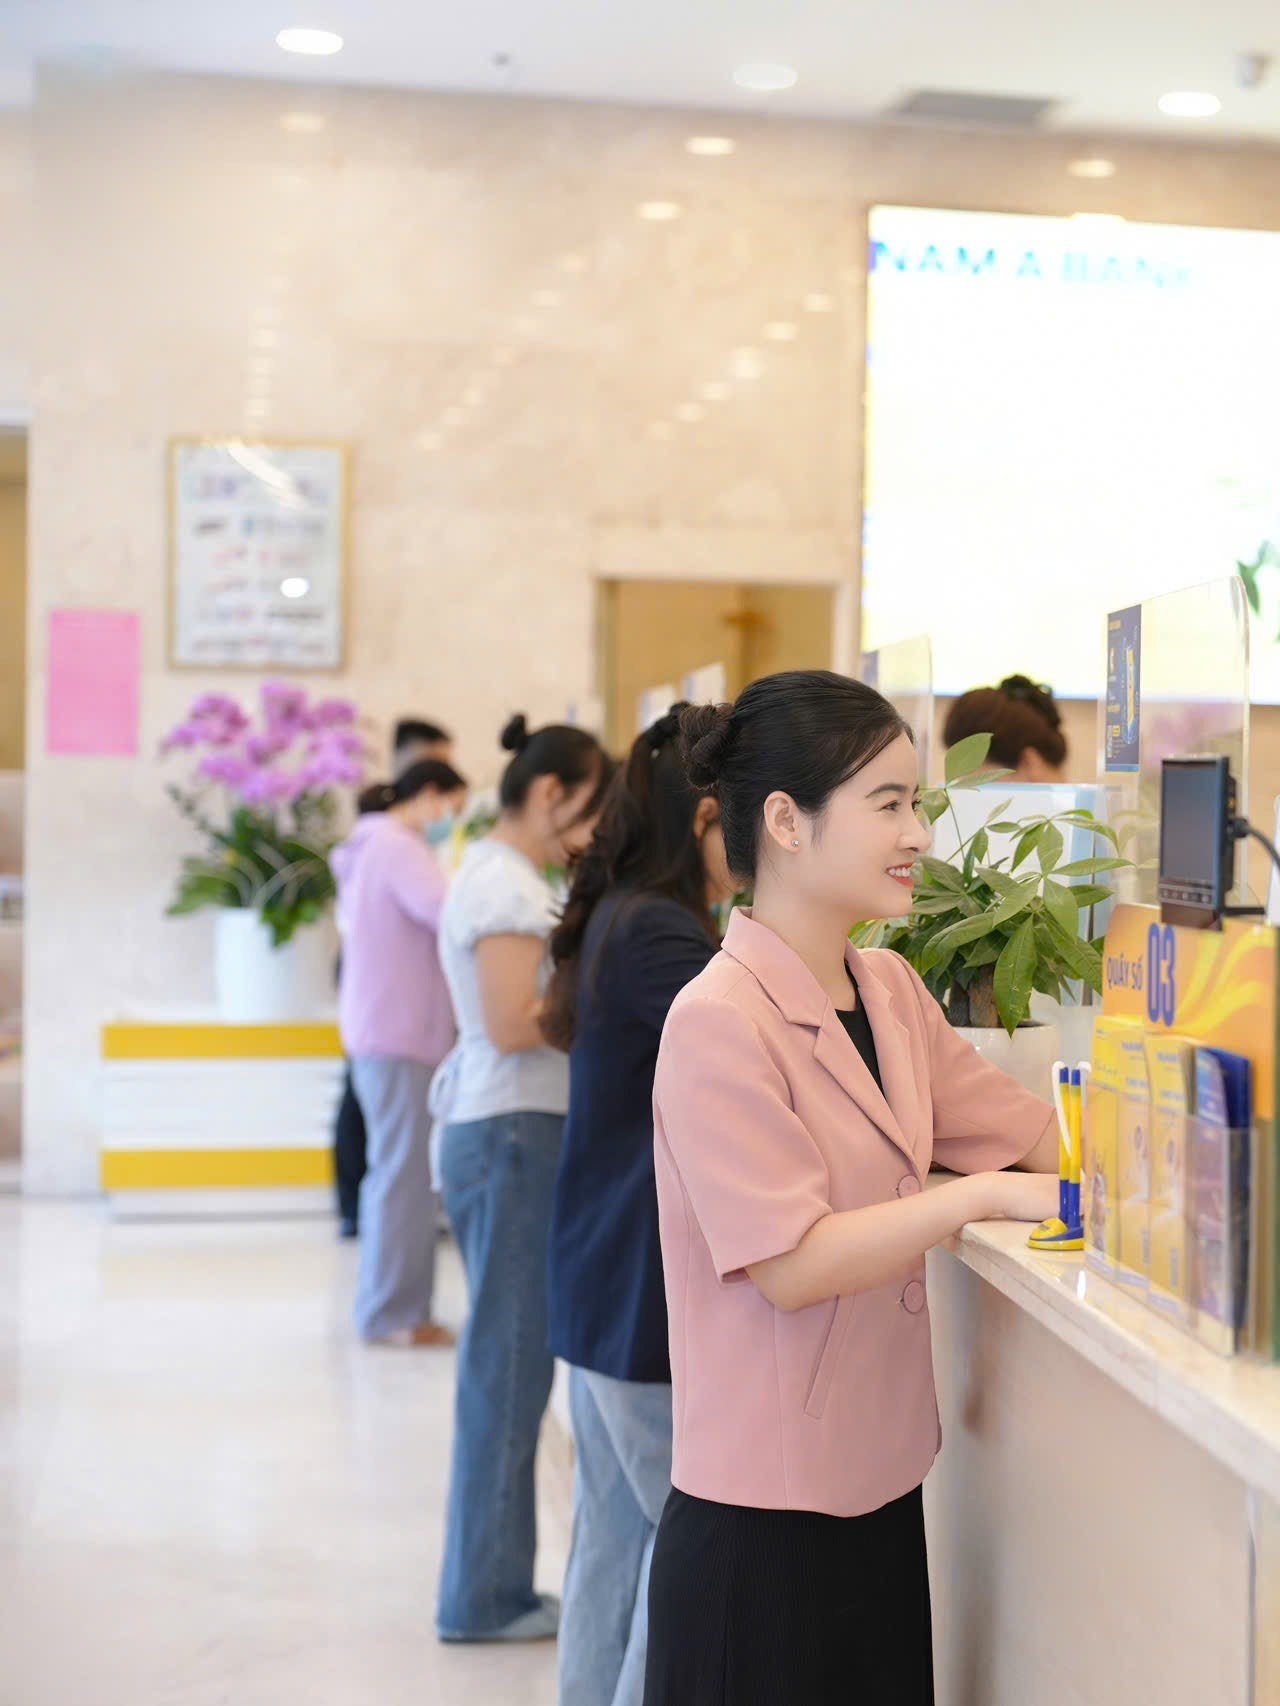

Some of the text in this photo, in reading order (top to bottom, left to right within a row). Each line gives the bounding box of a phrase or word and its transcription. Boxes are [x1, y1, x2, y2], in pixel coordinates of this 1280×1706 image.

[868, 240, 995, 276] NAM
[1015, 249, 1043, 278] A
[1147, 922, 1176, 1028] 03
